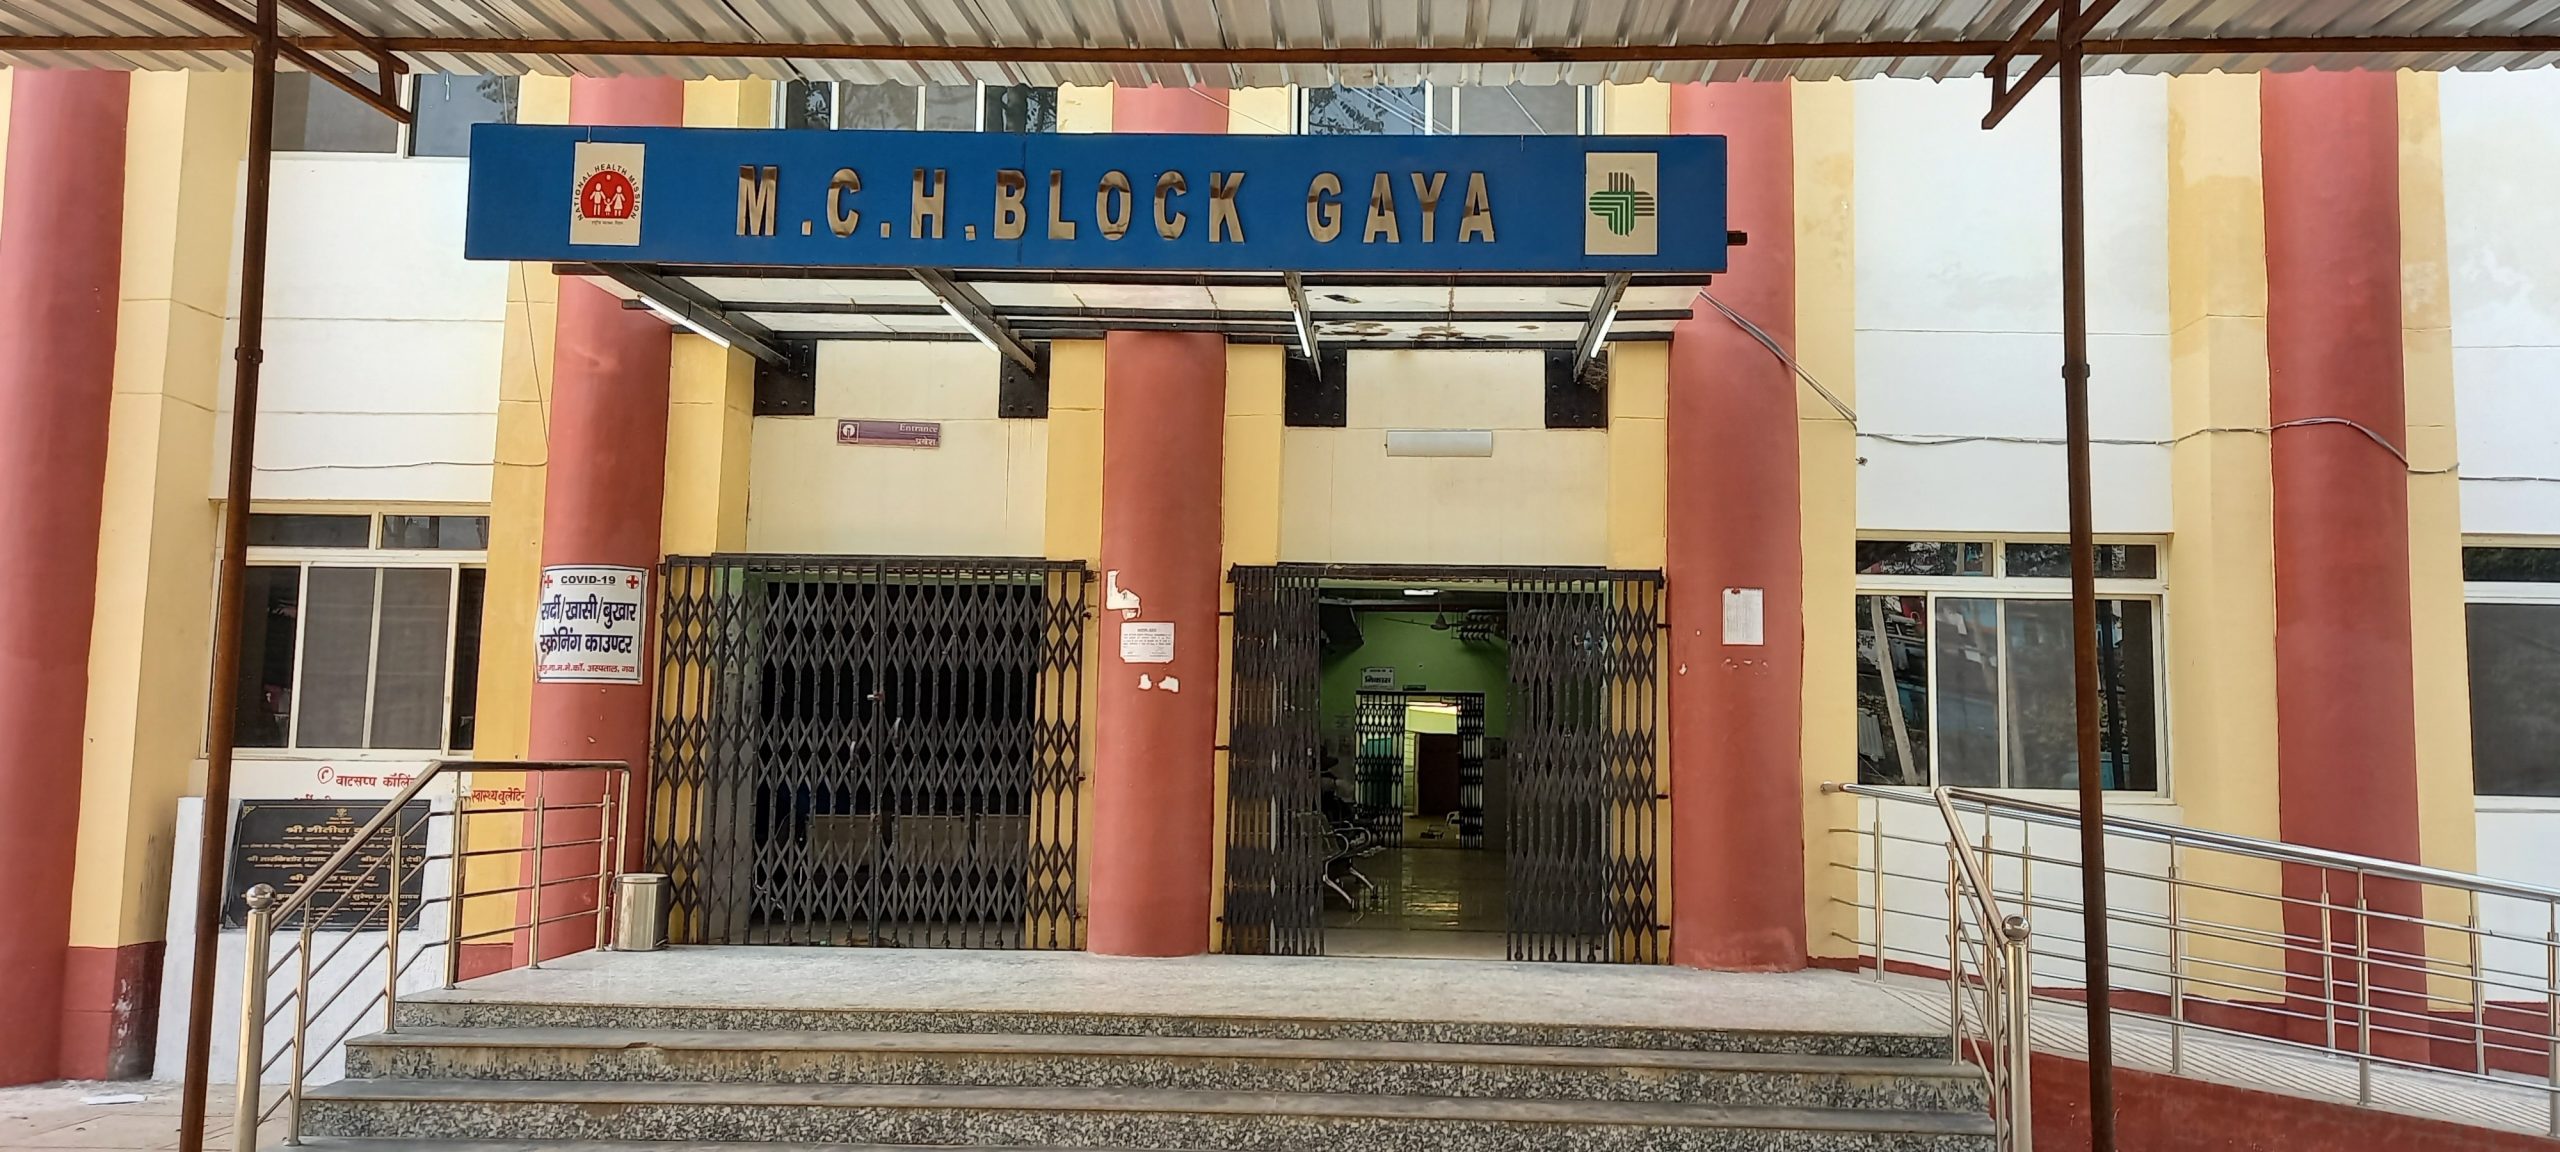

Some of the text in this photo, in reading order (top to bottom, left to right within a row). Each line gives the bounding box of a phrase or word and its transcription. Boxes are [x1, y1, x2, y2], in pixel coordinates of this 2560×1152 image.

[574, 163, 641, 221] NATIONAL HEALTH MISSION
[1306, 171, 1496, 244] GAYA
[899, 423, 938, 433] Entrance
[915, 436, 937, 446] प्रवेश
[560, 575, 616, 585] COVID-19
[585, 634, 634, 654] काउण्टर
[383, 772, 417, 788] कॉलिं
